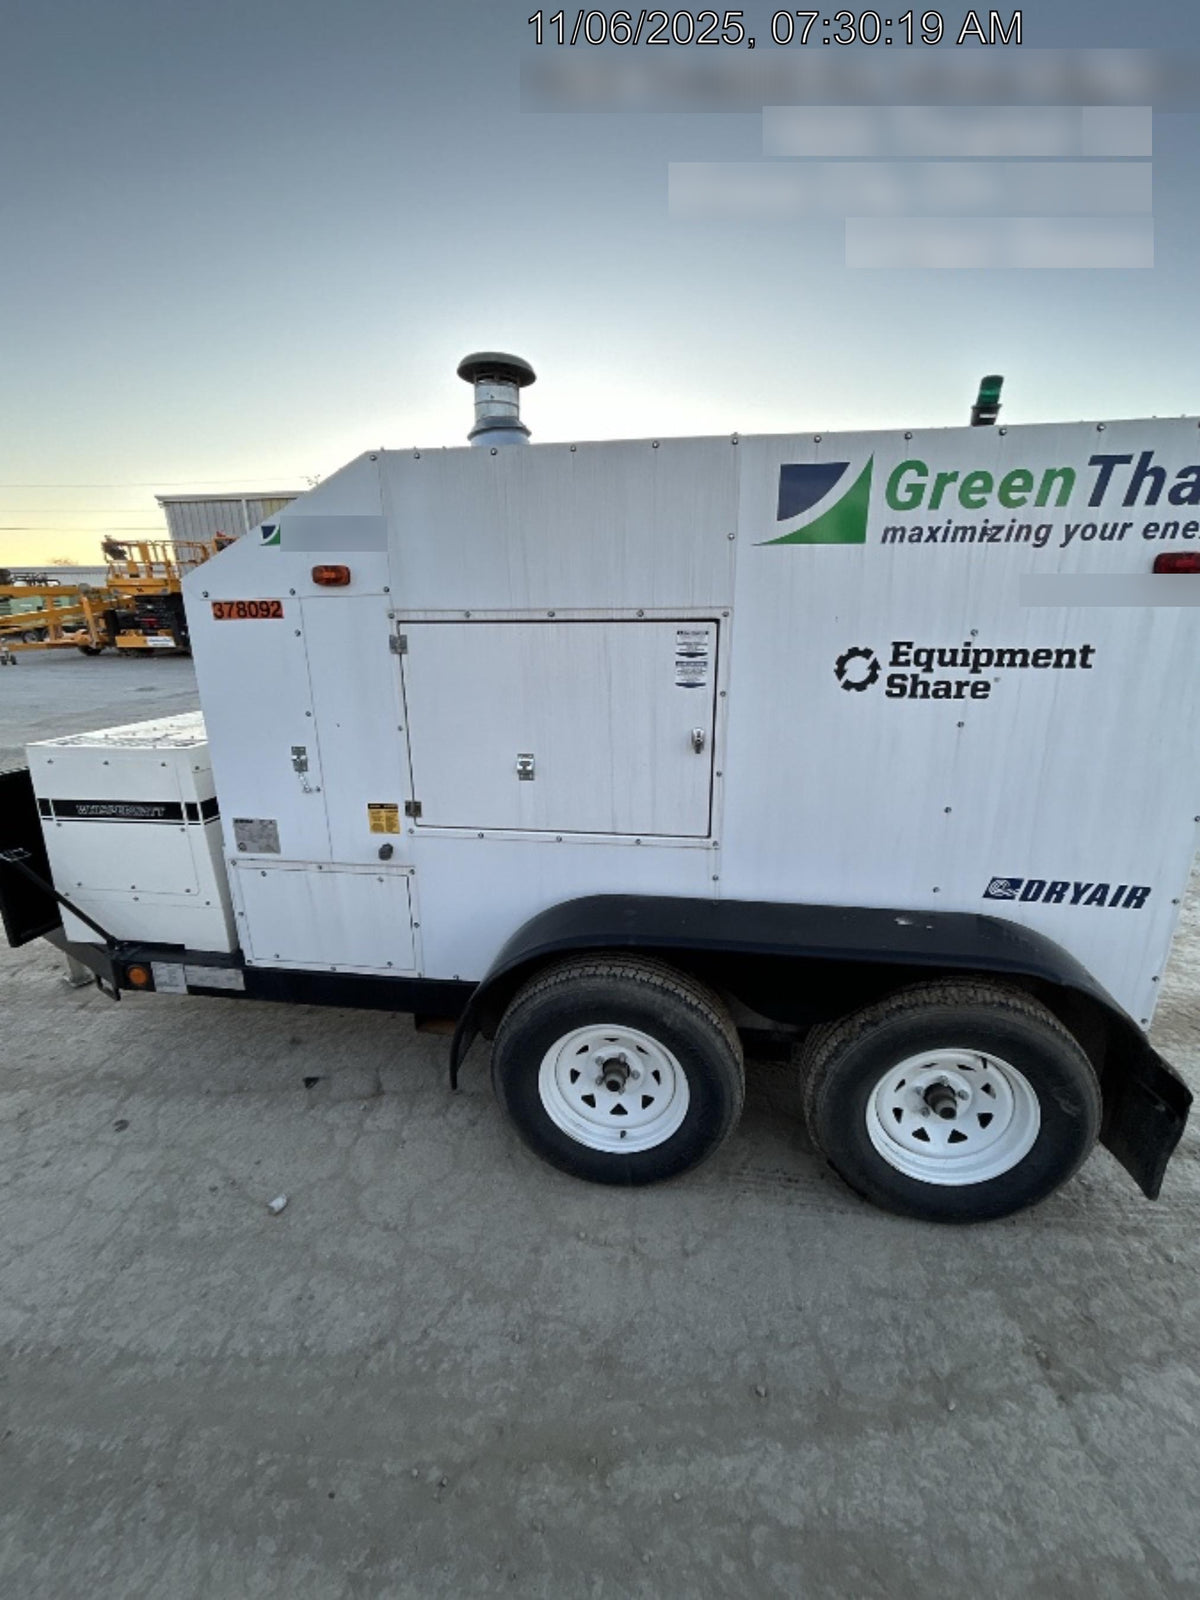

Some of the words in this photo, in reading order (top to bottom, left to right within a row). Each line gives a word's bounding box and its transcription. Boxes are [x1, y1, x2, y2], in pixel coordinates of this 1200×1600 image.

[880, 518, 1053, 549] maximizing
[1060, 521, 1134, 548] your
[1142, 519, 1200, 540] ene
[213, 600, 284, 619] 378092
[888, 641, 1096, 674] Equipment
[885, 673, 991, 699] Share
[1019, 878, 1152, 910] DRYAIR
